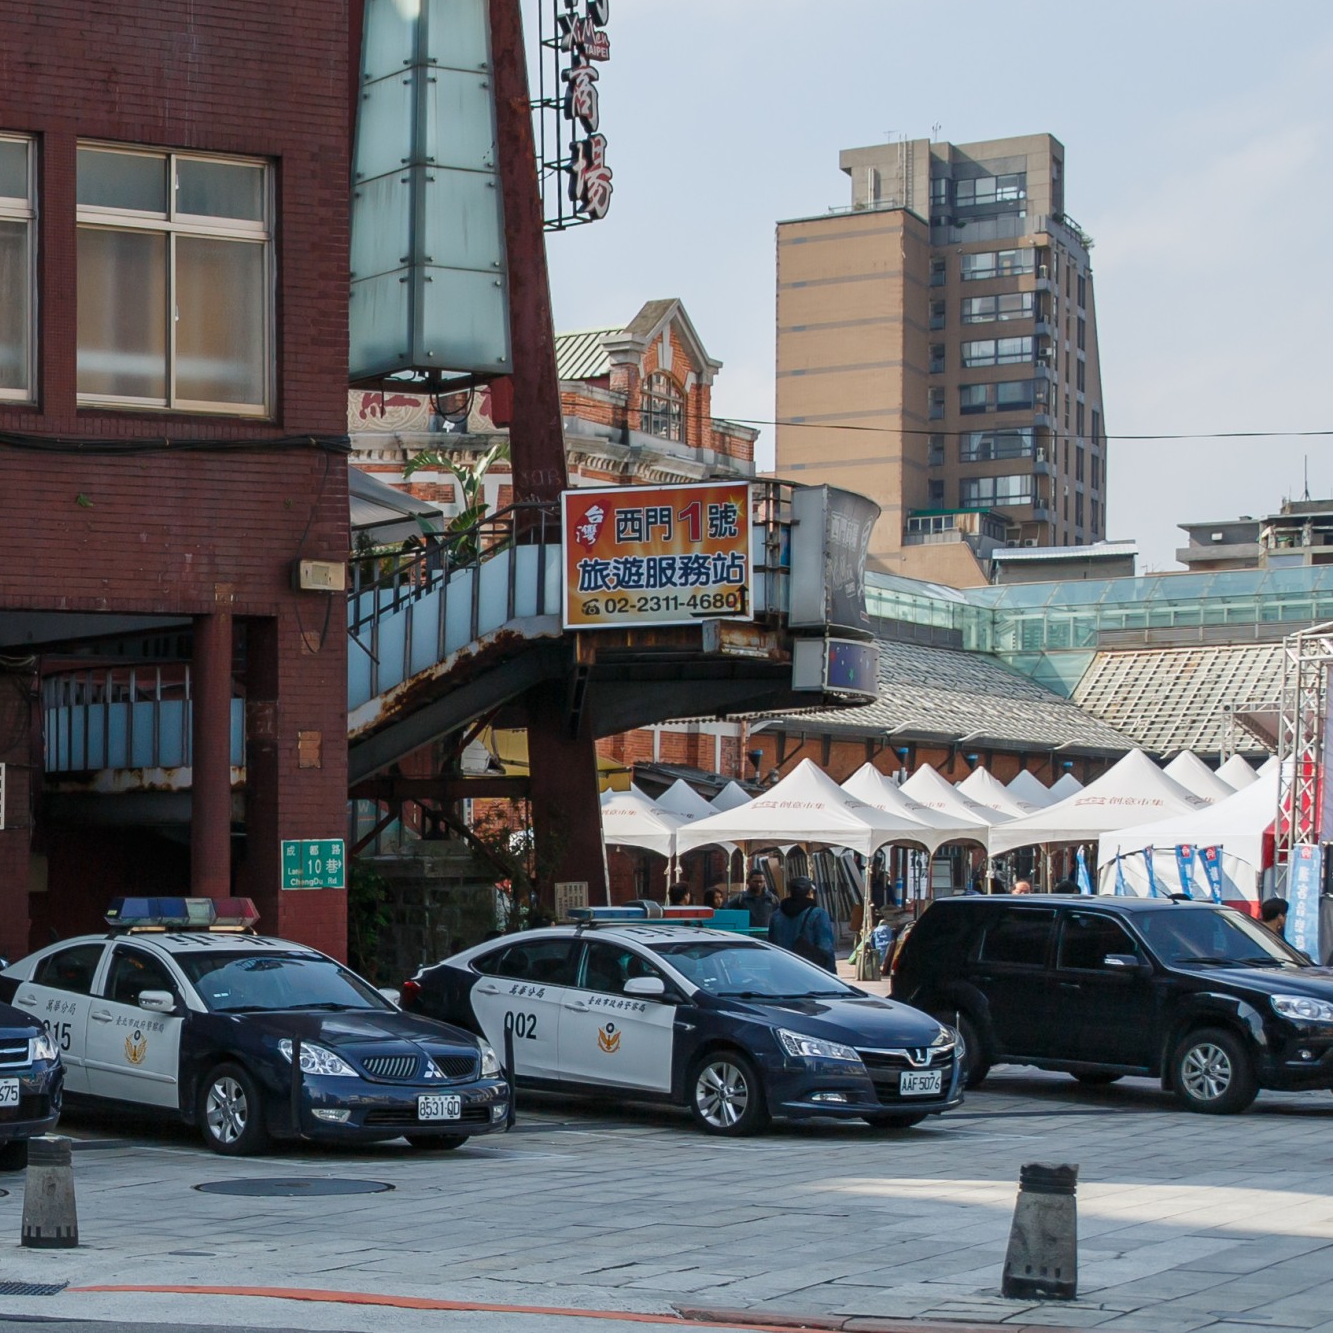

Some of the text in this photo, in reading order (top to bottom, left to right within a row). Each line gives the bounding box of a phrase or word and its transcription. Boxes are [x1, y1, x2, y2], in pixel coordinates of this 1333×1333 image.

[614, 501, 739, 544] 西門1號
[577, 552, 746, 593] 旅遊服務站
[603, 593, 738, 614] 02-2311-4680
[286, 844, 341, 857] 成都路
[308, 859, 322, 874] 10
[901, 1076, 941, 1092] AAF-5076
[419, 1101, 460, 1117] 8531-QD
